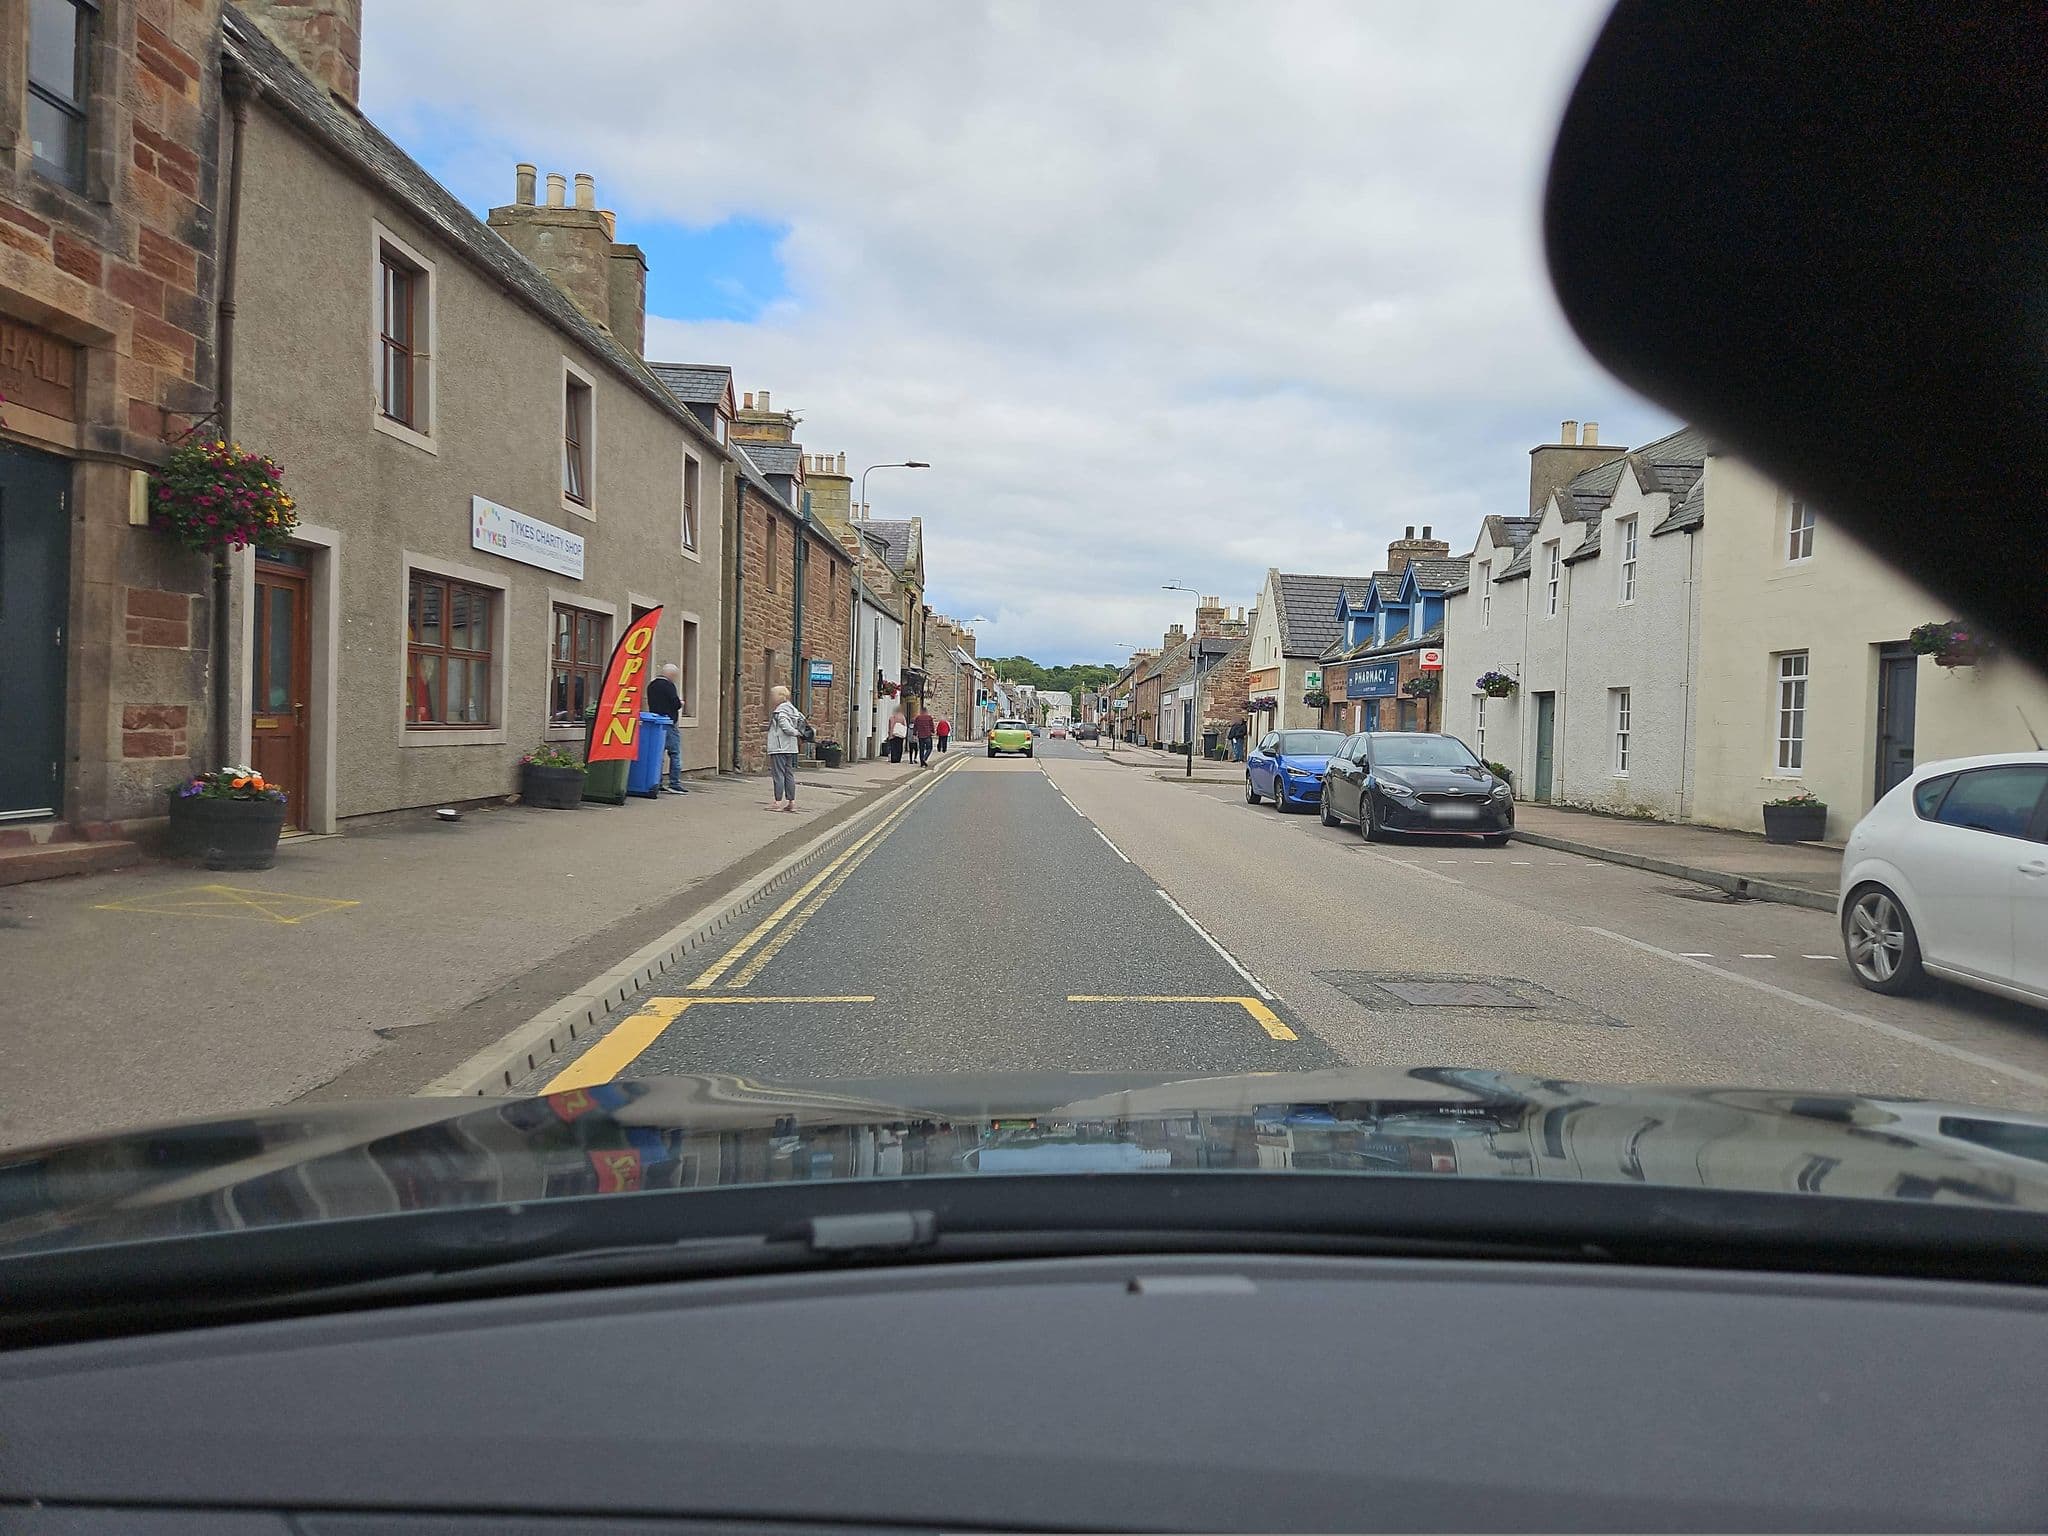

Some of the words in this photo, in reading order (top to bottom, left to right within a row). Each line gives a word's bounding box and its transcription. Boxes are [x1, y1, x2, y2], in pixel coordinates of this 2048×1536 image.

[1, 328, 70, 390] HALL
[481, 527, 507, 548] TYKES
[510, 519, 535, 540] TYKES
[535, 529, 564, 550] CHARITY
[565, 539, 582, 555] SHOP
[602, 627, 652, 745] OPEN
[1355, 669, 1387, 684] PHARMACY
